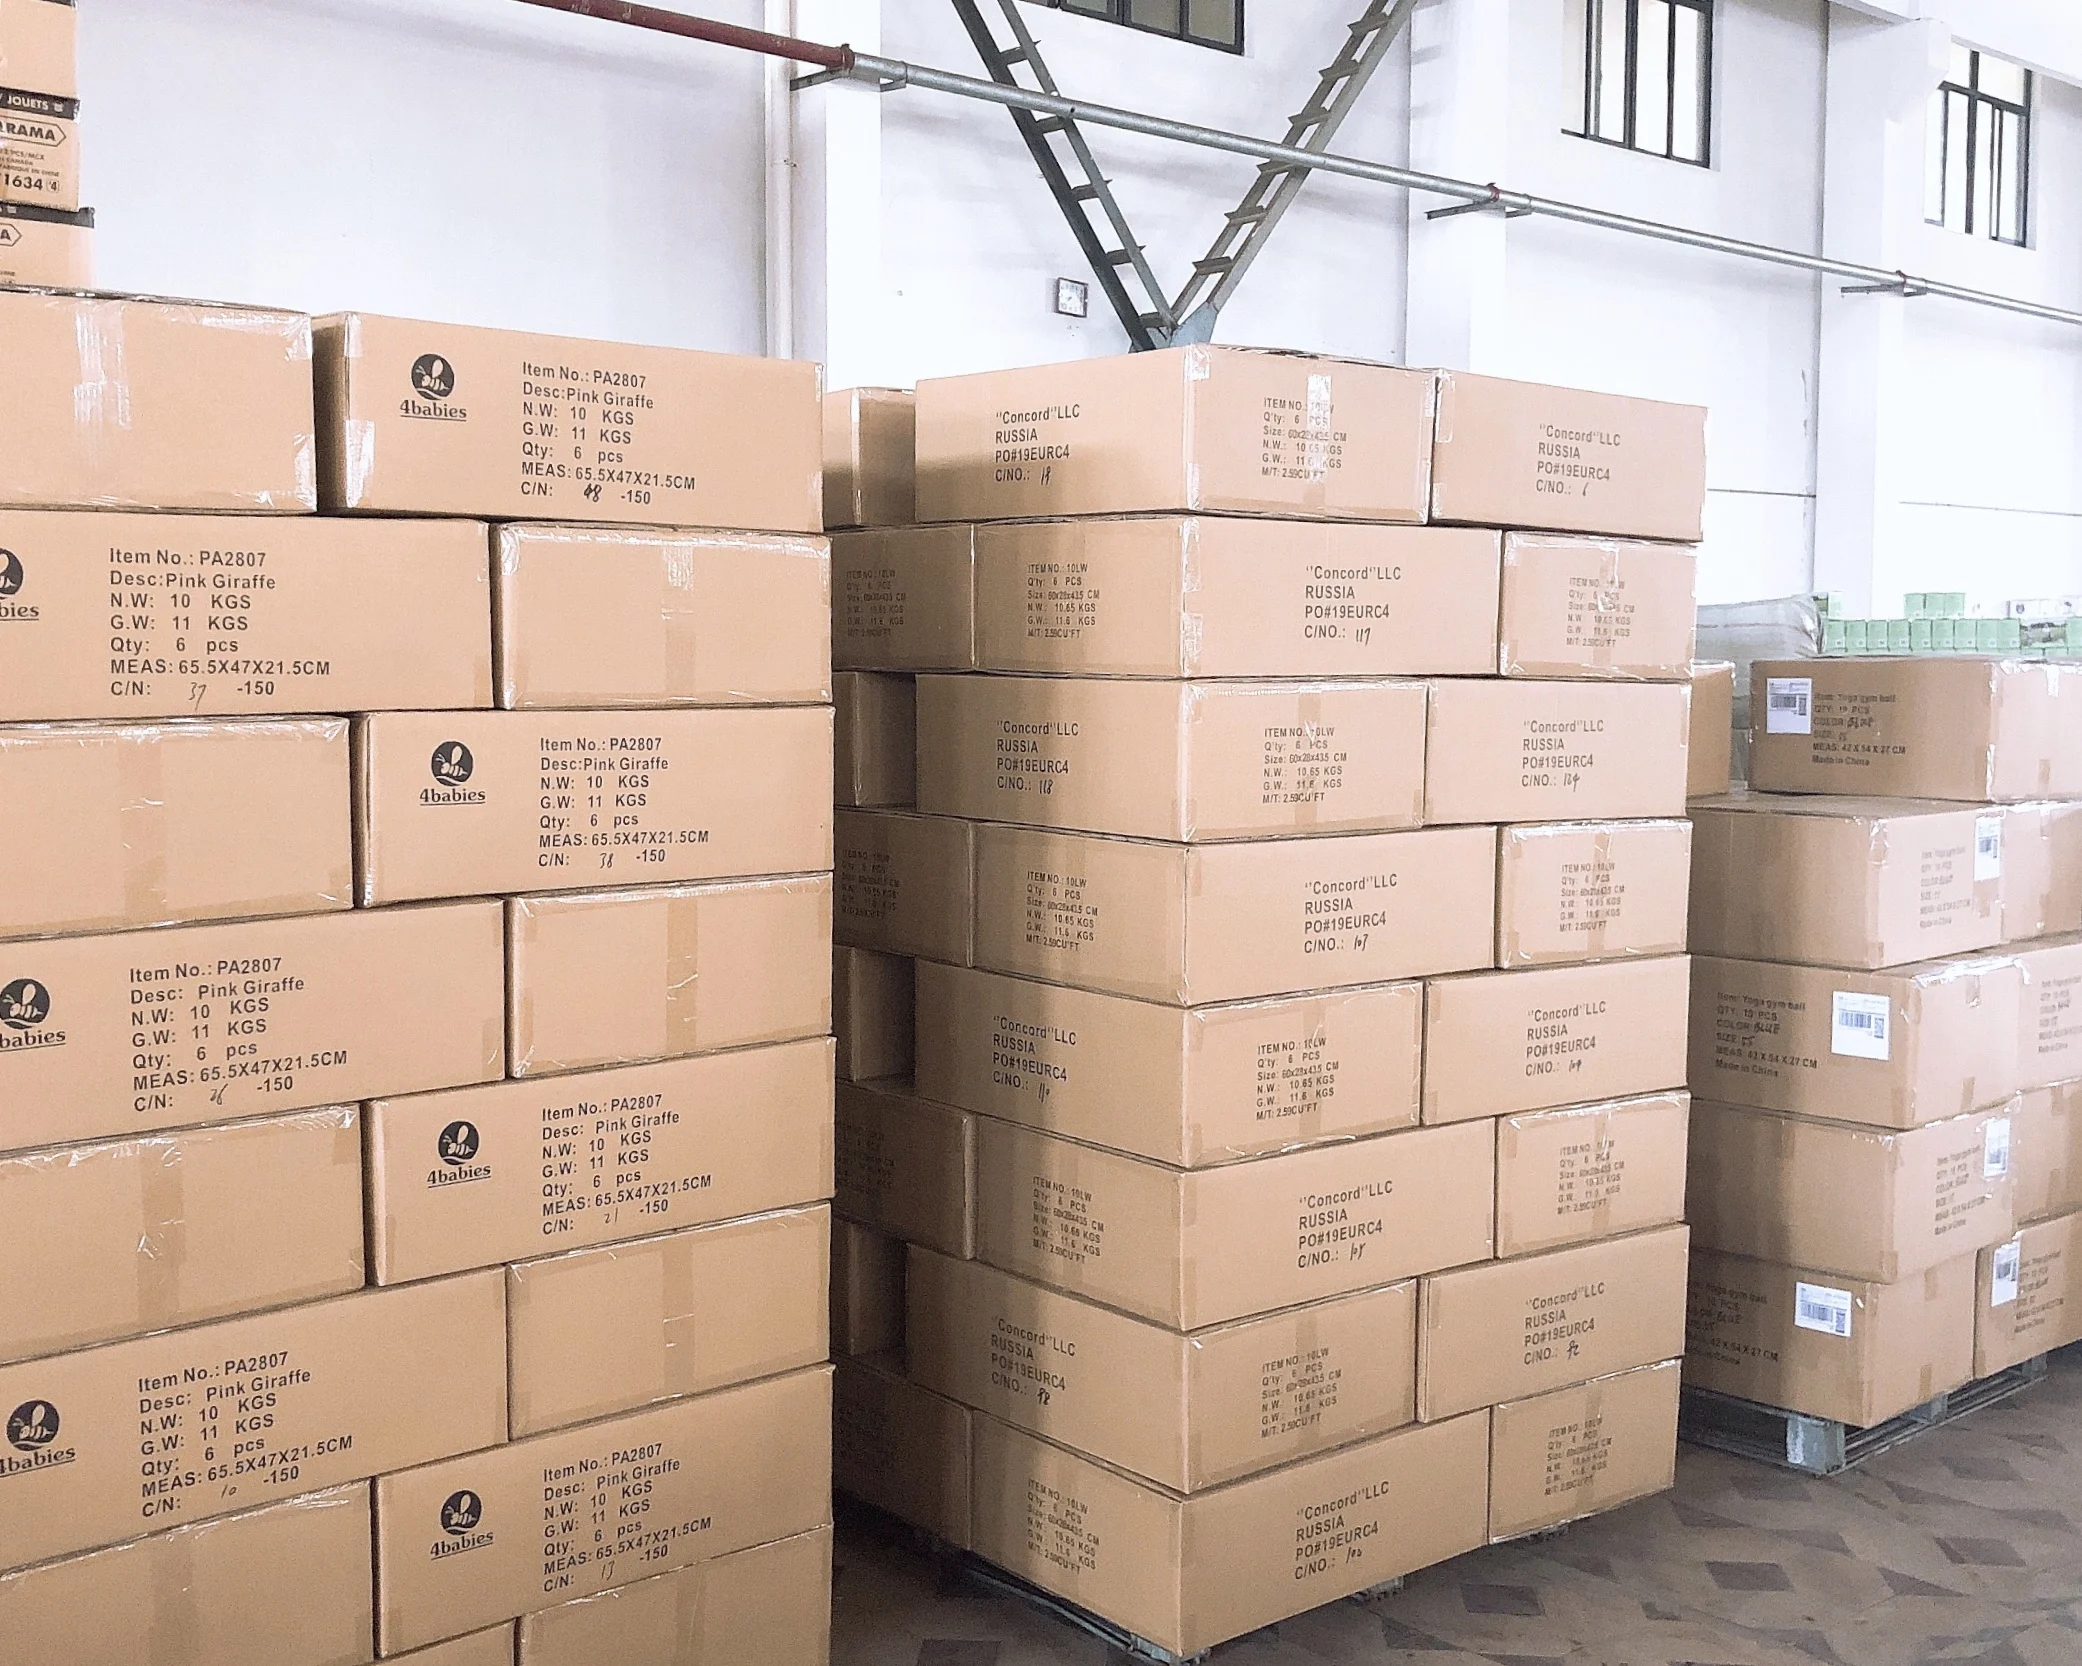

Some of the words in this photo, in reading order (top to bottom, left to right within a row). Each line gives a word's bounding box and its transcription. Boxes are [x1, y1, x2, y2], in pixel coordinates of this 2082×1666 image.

[7, 94, 49, 110] JOUETS
[4, 173, 43, 191] 1634
[523, 361, 554, 378] Item
[560, 366, 588, 382] No.:
[594, 370, 646, 388] PA2807
[399, 399, 468, 419] 4babies
[604, 392, 653, 409] Giraffe
[524, 401, 558, 418] N.W:
[571, 406, 586, 420] 10
[603, 409, 633, 425] KGS
[523, 422, 558, 437] G.W:
[572, 426, 585, 440] 11
[600, 428, 631, 444] KGS
[996, 428, 1038, 444] RUSSIA
[523, 442, 553, 460] Qty:
[574, 446, 581, 459] 6
[598, 451, 623, 464] pcs
[996, 444, 1069, 463] PO#19EURC4
[1539, 442, 1580, 459] RUSSIA
[522, 462, 571, 478] MEAS:
[576, 467, 695, 490] 65.5X47X21.5CM
[996, 468, 1030, 481] C/NO.:
[1538, 461, 1610, 481] PO#19EURC4
[521, 481, 552, 496] C/N:
[621, 490, 650, 504] -150
[1536, 479, 1571, 495] C/NO.:
[110, 548, 150, 564] Item
[157, 549, 193, 565] No.:
[200, 550, 266, 567] PA2807
[213, 574, 275, 589] Giraffe
[111, 592, 153, 608] N.W:
[171, 594, 190, 608] 10
[211, 594, 250, 609] KGS
[1306, 585, 1355, 599] RUSSIA
[1305, 604, 1389, 618] PO#19EURC4
[111, 614, 155, 630] G.W:
[173, 616, 189, 630] 11
[208, 616, 248, 631] KGS
[1305, 625, 1345, 638] C/NO.:
[111, 637, 149, 656] Qty:
[176, 637, 185, 651] 6
[207, 641, 238, 655] pcs
[111, 659, 173, 674] MEAS:
[179, 660, 329, 675] 65.5X47X21.5CM
[111, 680, 150, 696] C/N:
[237, 681, 274, 695] -150
[541, 738, 572, 751] Item
[577, 738, 605, 751] No.:
[610, 738, 661, 751] PA2807
[997, 739, 1038, 753] RUSSIA
[1523, 738, 1564, 751] RUSSIA
[620, 757, 668, 770] Giraffe
[997, 758, 1068, 774] PO#19EURC4
[1523, 754, 1593, 769] PO#19EURC4
[541, 776, 574, 790] N.W:
[587, 776, 602, 788] 10
[619, 775, 649, 788] KGS
[998, 776, 1031, 790] C/NO.:
[1522, 774, 1556, 787] C/NO.:
[419, 788, 487, 804] 4babies
[541, 796, 574, 809] G.W:
[588, 795, 601, 808] 11
[616, 794, 646, 807] KGS
[540, 815, 570, 831] Qty:
[590, 814, 597, 826] 6
[614, 815, 638, 829] pcs
[540, 833, 587, 848] MEAS:
[592, 830, 709, 846] 65.5X47X21.5CM
[539, 853, 569, 867] C/N:
[636, 849, 665, 862] -150
[1305, 897, 1353, 915] RUSSIA
[1305, 911, 1386, 934] PO#19EURC4
[1304, 938, 1343, 953] C/NO.:
[994, 1034, 1035, 1055] RUSSIA
[1257, 1043, 1280, 1055] ITEM
[1288, 1054, 1293, 1064] 6
[1302, 1051, 1320, 1061] PCS
[1326, 1061, 1339, 1071] CM
[993, 1052, 1066, 1085] PO#19EURC4
[994, 1071, 1028, 1090] C/NO.:
[1316, 1074, 1335, 1086] KGS
[1315, 1087, 1334, 1099] KGS
[428, 1164, 491, 1184] 4babies
[544, 1466, 575, 1482] Item
[579, 1457, 610, 1477] No.:
[612, 1443, 662, 1465] PA2807
[545, 1482, 585, 1501] Desc:
[597, 1470, 628, 1490] Pink
[633, 1459, 680, 1479] Giraffe
[544, 1500, 578, 1520] N.W:
[591, 1493, 606, 1508] 10
[622, 1480, 652, 1499] KGS
[545, 1518, 579, 1537] G.W:
[591, 1509, 604, 1524] 11
[620, 1499, 650, 1518] KGS
[1296, 1515, 1345, 1542] RUSSIA
[430, 1533, 494, 1558] 4babies
[544, 1540, 574, 1556] Qty:
[595, 1529, 602, 1542] 6
[618, 1521, 642, 1539] pcs
[544, 1552, 593, 1575] MEAS:
[595, 1517, 711, 1561] 65.5X47X21.5CM
[1296, 1521, 1378, 1560] PO#19EURC4
[544, 1574, 574, 1592] C/N:
[640, 1544, 667, 1561] -150
[1295, 1558, 1335, 1579] C/NO.:
